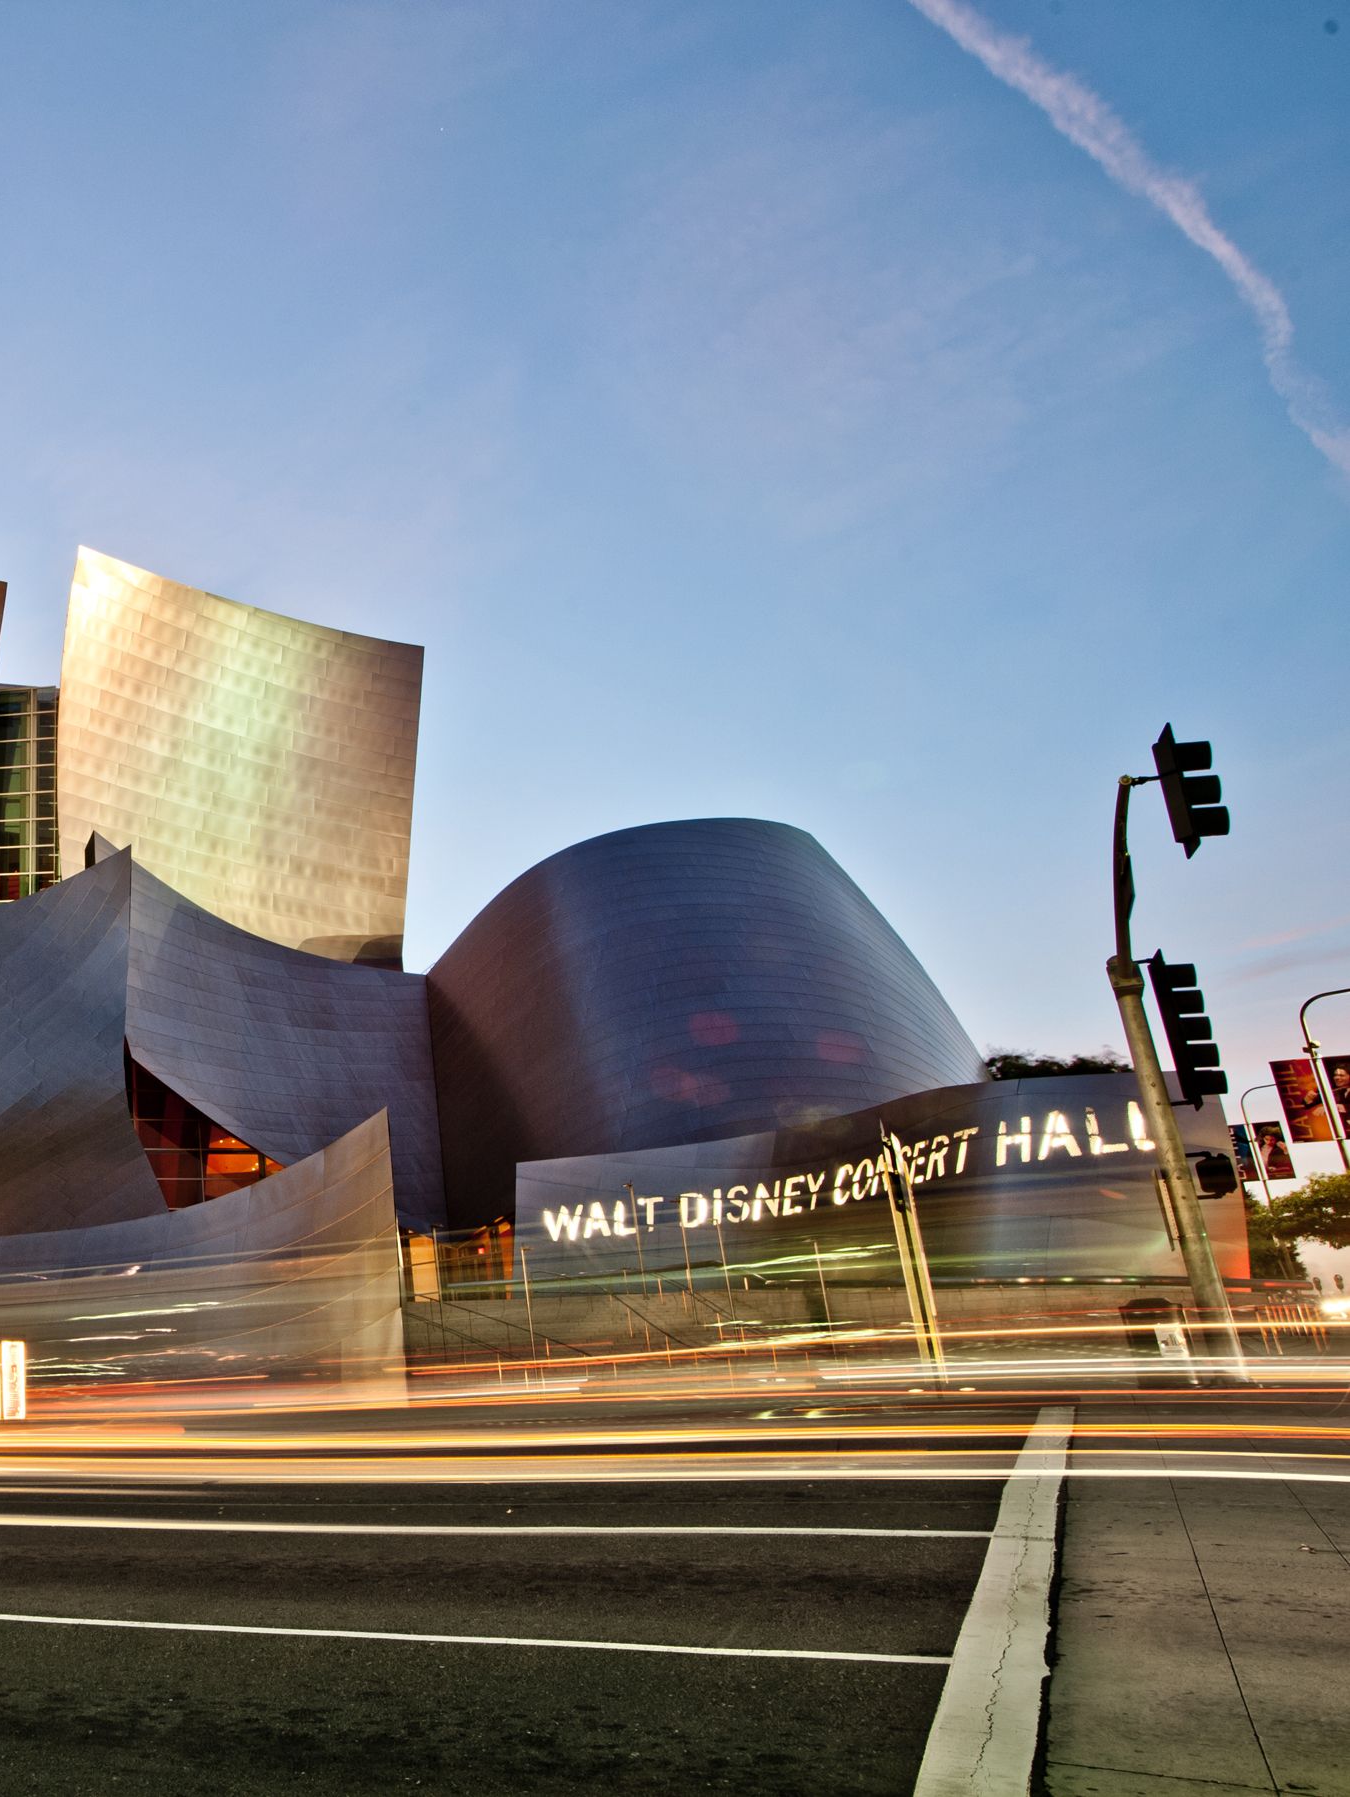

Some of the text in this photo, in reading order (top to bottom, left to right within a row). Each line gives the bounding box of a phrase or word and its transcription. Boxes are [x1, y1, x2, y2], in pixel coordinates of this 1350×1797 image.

[543, 1197, 664, 1241] WALT
[679, 1170, 826, 1228] DISNEY
[996, 1101, 1156, 1166] HALL
